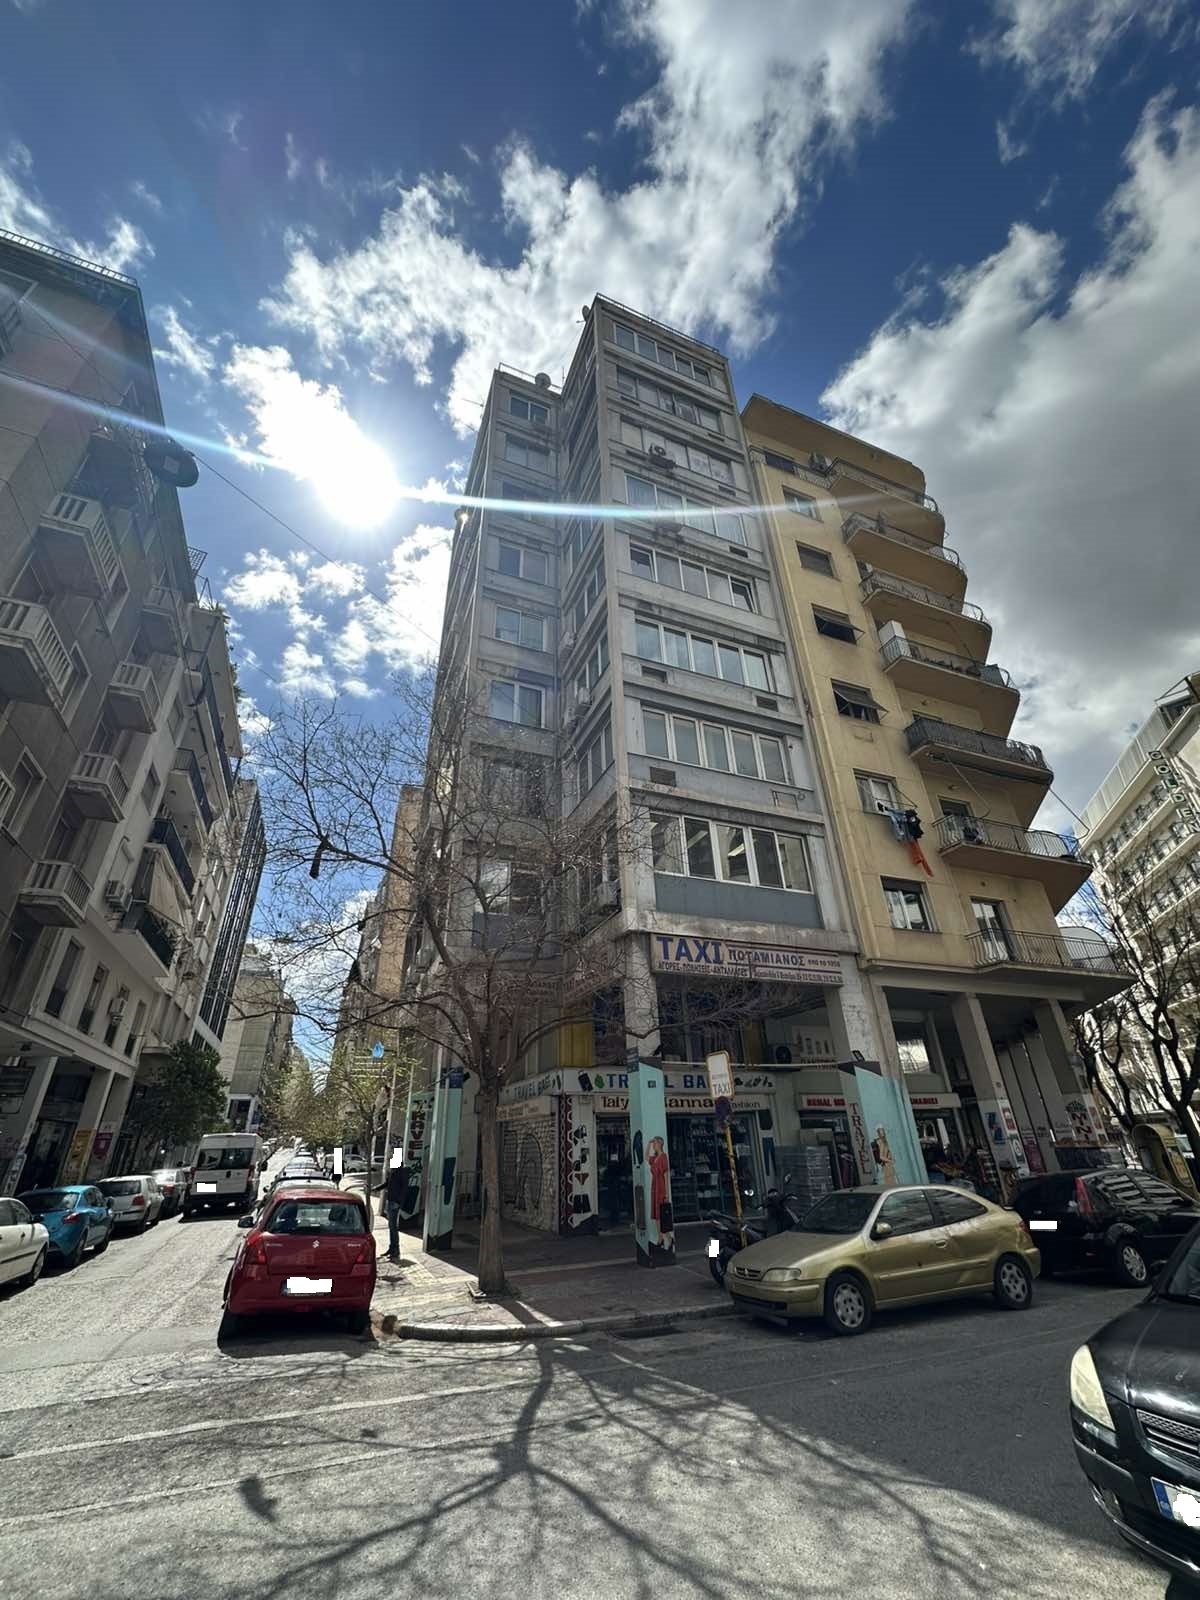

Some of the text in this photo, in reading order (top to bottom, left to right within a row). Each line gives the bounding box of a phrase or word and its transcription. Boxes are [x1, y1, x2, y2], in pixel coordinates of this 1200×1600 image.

[1149, 751, 1200, 833] GOLDEN
[656, 936, 723, 964] TAXI
[713, 1083, 730, 1095] TAXI
[850, 1103, 873, 1174] TRAVEL
